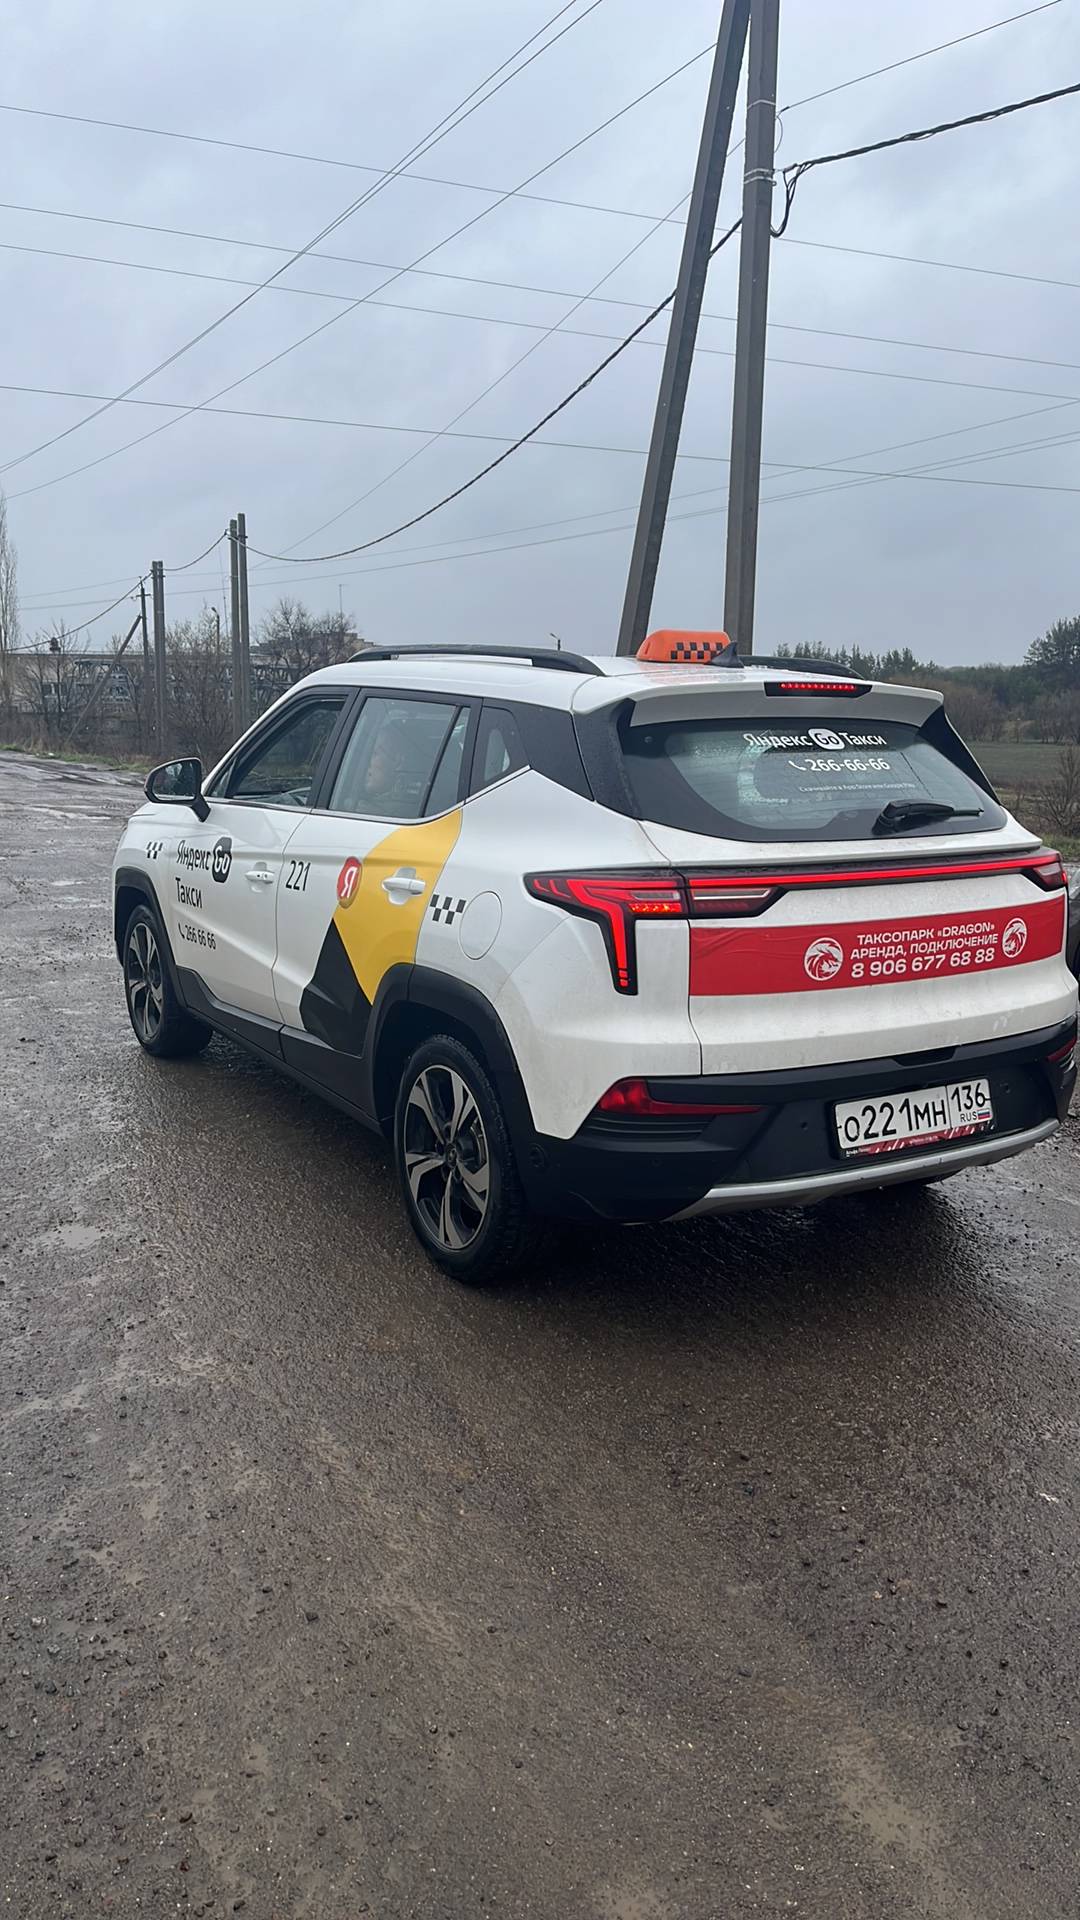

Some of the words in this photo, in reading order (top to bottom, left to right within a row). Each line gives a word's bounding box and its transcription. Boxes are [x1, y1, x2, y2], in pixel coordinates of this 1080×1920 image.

[743, 733, 813, 748] Яндекс
[812, 731, 842, 747] Go
[840, 732, 887, 746] Такси
[805, 758, 891, 772] 266-66-66
[176, 840, 211, 871] Яндекс
[213, 843, 232, 876] Go
[285, 860, 311, 891] 221
[341, 866, 358, 898] Я
[175, 877, 203, 909] Такси
[185, 924, 198, 943] 266
[198, 930, 207, 947] 66
[207, 933, 217, 950] 66
[850, 945, 907, 960] АРЕНДА,
[910, 933, 998, 955] ПОДКЛЮЧЕНИЕ
[857, 928, 935, 945] ТАКСОПАРК
[937, 922, 995, 938] «DRAGON»
[851, 963, 865, 978] 8
[870, 959, 907, 977] 906
[911, 954, 946, 972] 677
[950, 951, 971, 967] 68
[975, 947, 995, 964] 88
[844, 1098, 947, 1142] О221МН
[951, 1082, 986, 1112] 136
[960, 1112, 977, 1122] RUS
